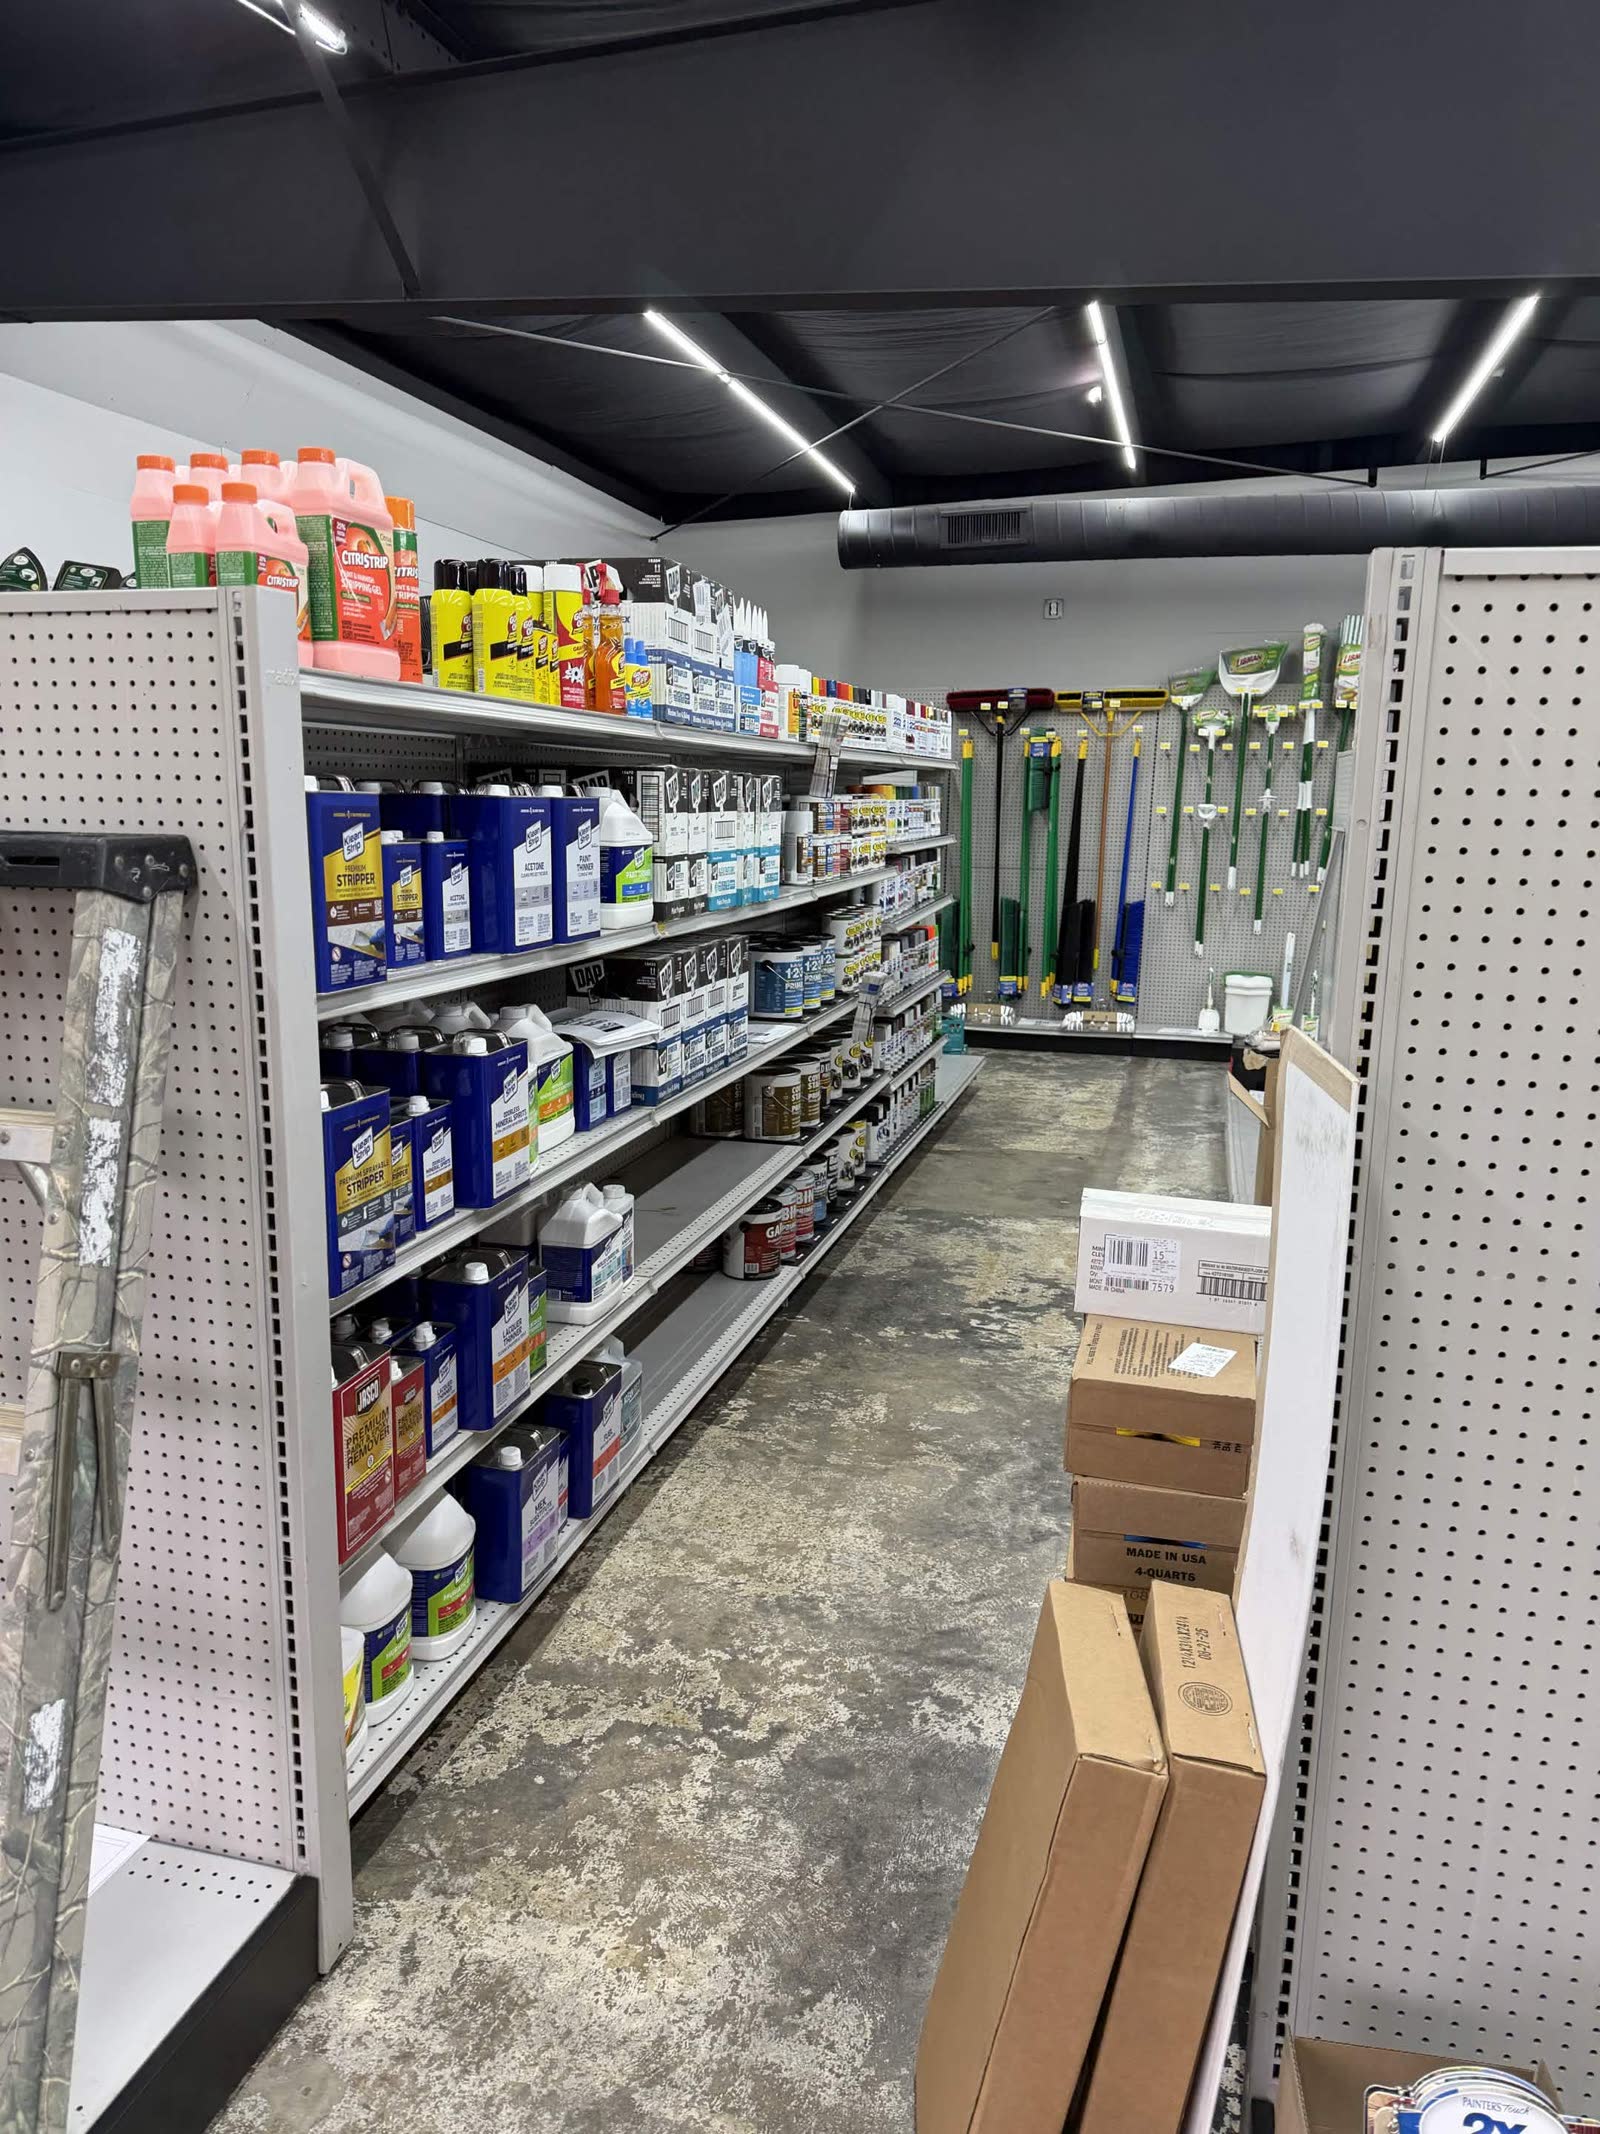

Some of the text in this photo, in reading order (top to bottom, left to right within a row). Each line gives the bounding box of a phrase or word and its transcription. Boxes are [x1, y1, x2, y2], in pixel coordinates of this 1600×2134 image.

[524, 862, 544, 871] ACETONE
[336, 872, 375, 887] STRIPPER
[346, 1170, 384, 1196] STRIPPER
[1153, 1250, 1165, 1260] 15
[1152, 1282, 1175, 1294] 7579
[358, 1379, 379, 1412] JASCO
[346, 1406, 390, 1449] PREMIUM
[346, 1425, 390, 1469] REMOVER
[1126, 1547, 1206, 1564] MADE IN USA
[1134, 1566, 1196, 1582] 4-QUARTS
[1462, 2096, 1531, 2115] PAINTERS Touch
[1462, 2112, 1528, 2134] 2X
